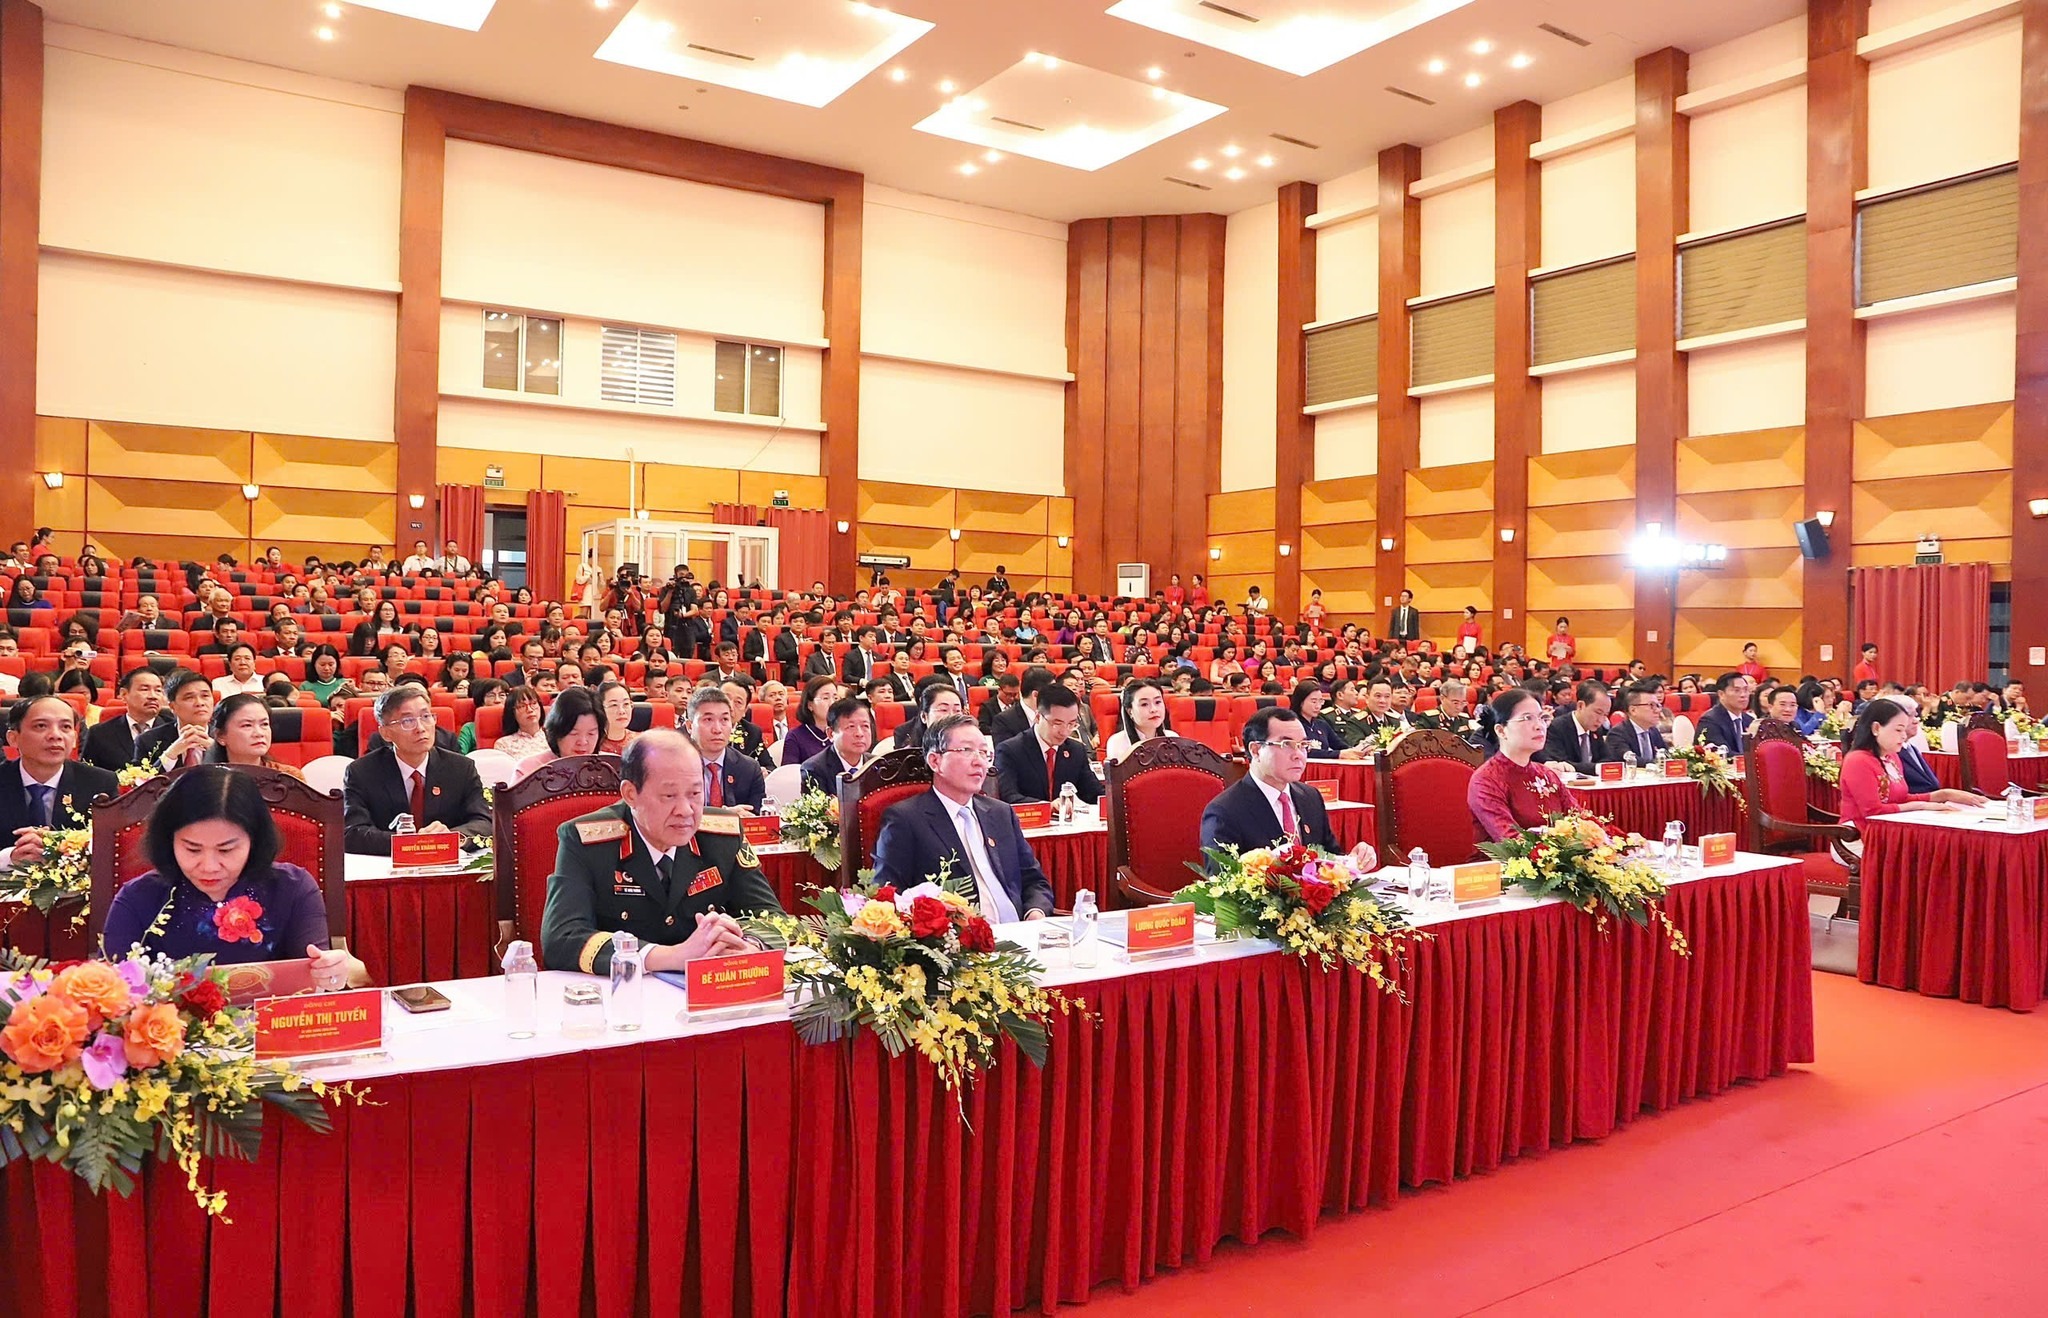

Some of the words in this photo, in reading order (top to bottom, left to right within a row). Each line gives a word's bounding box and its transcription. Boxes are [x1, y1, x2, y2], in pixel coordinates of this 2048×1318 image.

[1154, 918, 1170, 929] QUỐC
[714, 969, 736, 982] XUÂN
[738, 966, 769, 980] TRƯỜNG
[271, 1010, 313, 1030] NGUYỄN
[316, 1012, 332, 1026] THỊ
